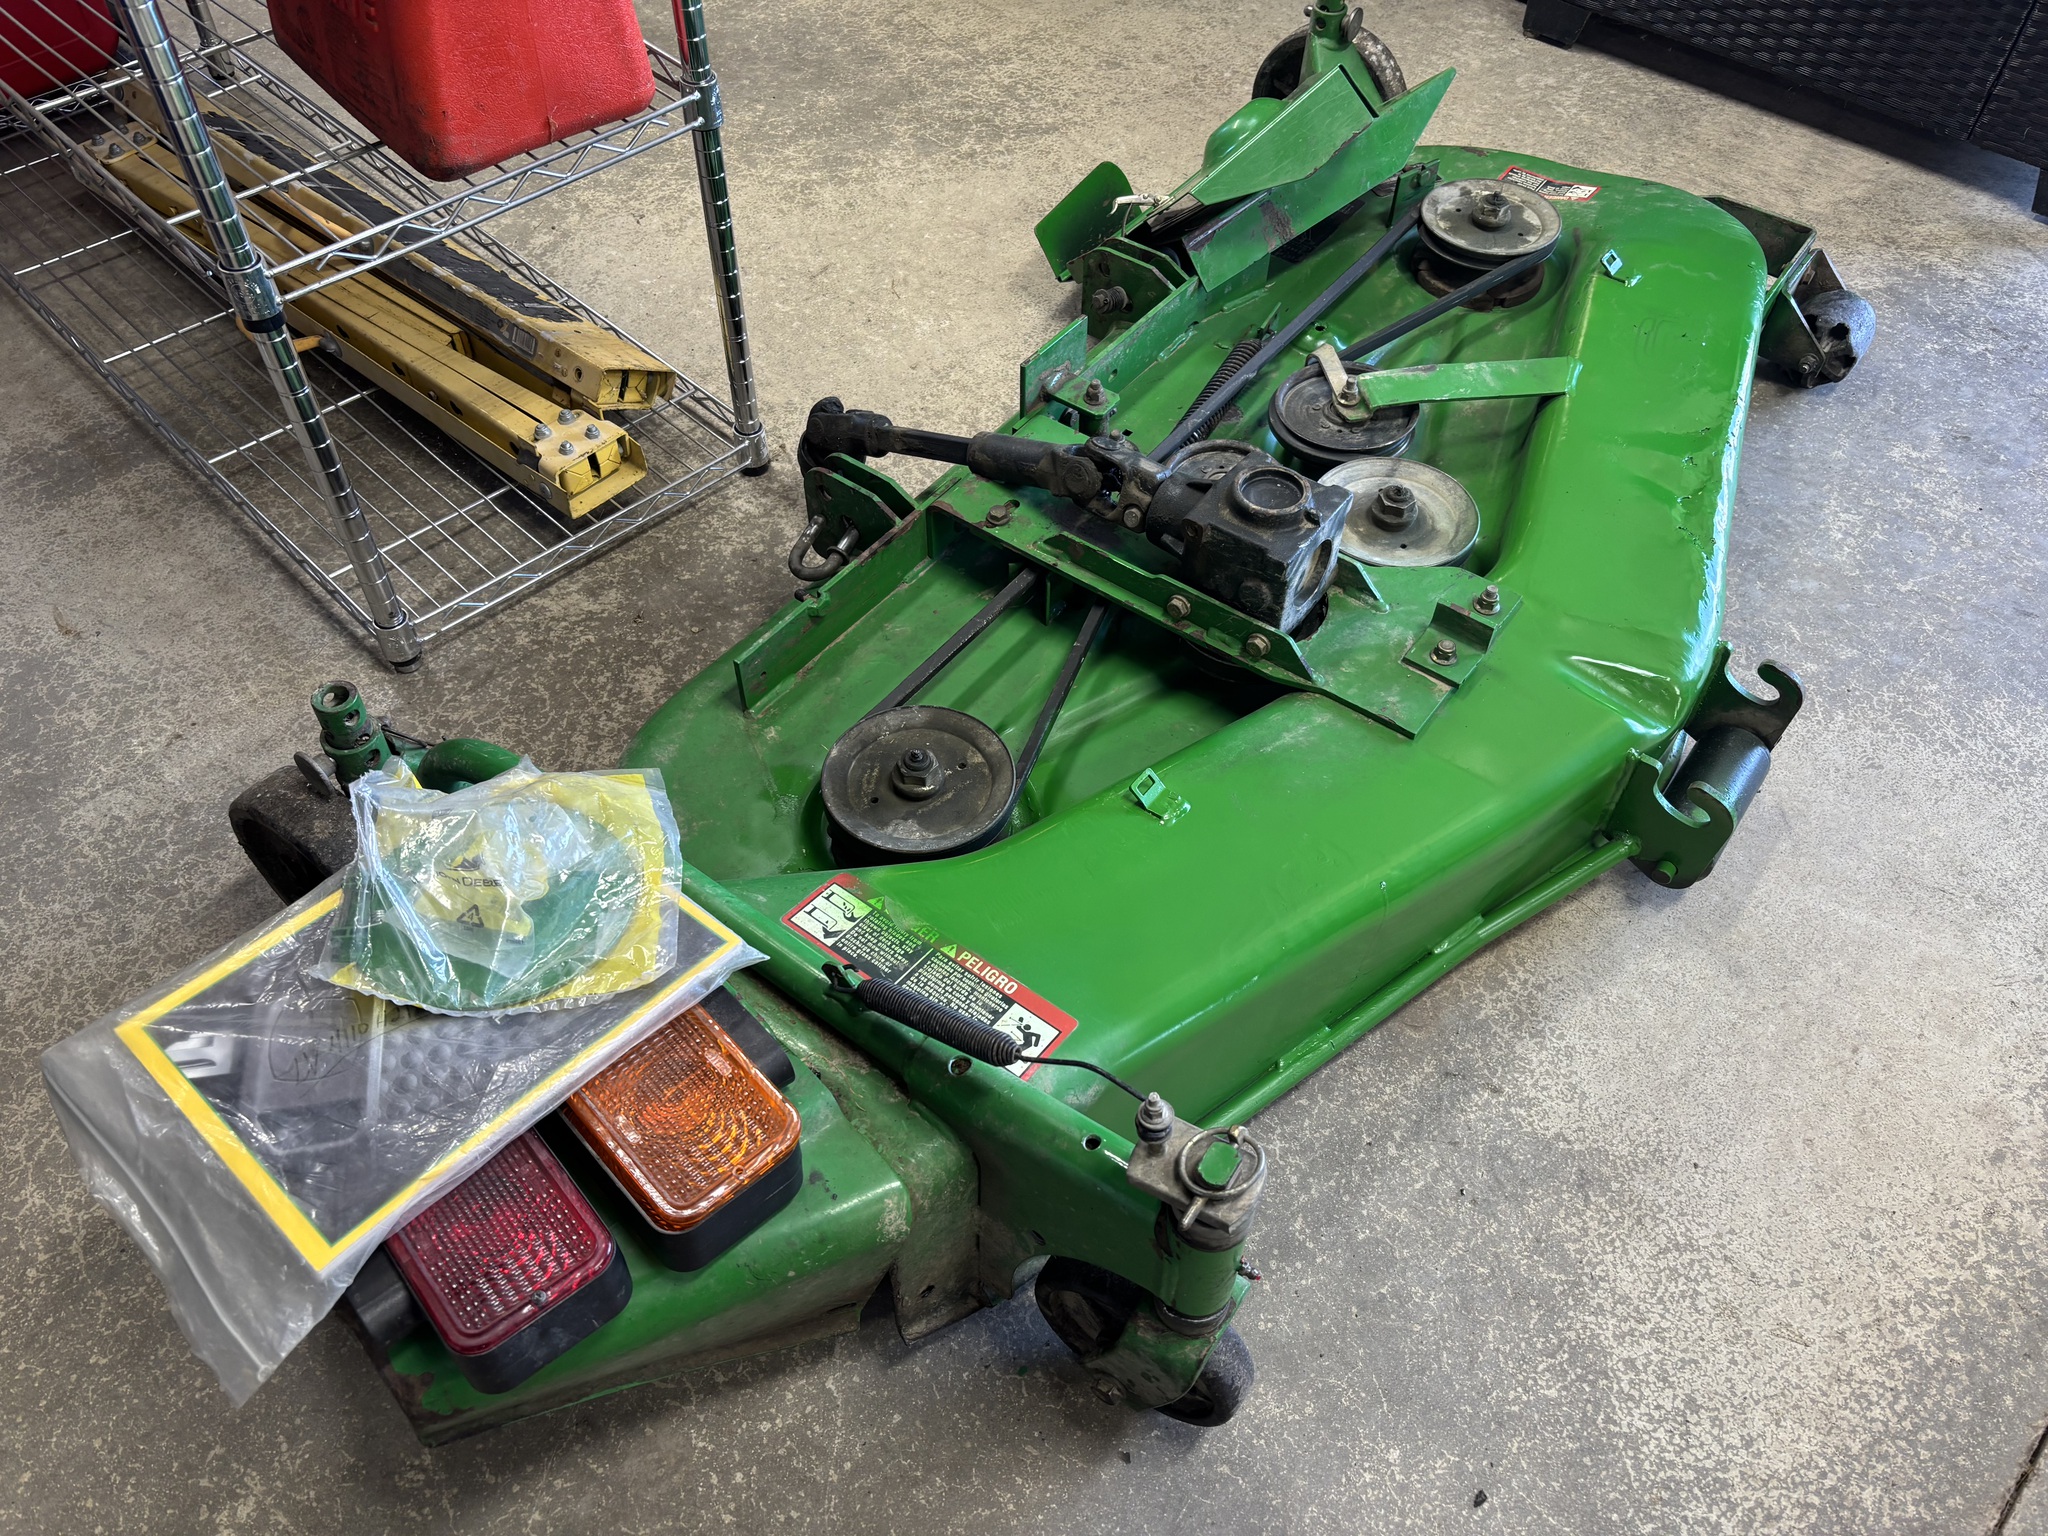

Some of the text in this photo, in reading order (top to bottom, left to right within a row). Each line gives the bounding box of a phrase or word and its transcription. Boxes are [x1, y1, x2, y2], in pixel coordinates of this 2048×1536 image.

[858, 922, 873, 932] clear
[878, 935, 892, 945] deck
[890, 944, 905, 954] edge
[862, 918, 882, 931] thrown
[900, 944, 914, 953] stay
[863, 933, 878, 943] keep
[876, 941, 895, 954] others
[866, 914, 889, 930] rotating
[887, 928, 906, 941] blades
[878, 915, 895, 926] avoid
[892, 925, 909, 937] injury
[909, 935, 922, 944] from
[840, 937, 891, 973] entire grass catcher
[841, 946, 860, 959] place.
[843, 933, 871, 952] discharge
[869, 950, 886, 962] chute
[878, 950, 900, 964] without
[921, 964, 943, 979] alejado
[951, 983, 969, 996] borde
[929, 962, 950, 977] objetos
[972, 990, 1004, 1012] mantenerse
[930, 956, 954, 973] causadas
[961, 976, 985, 993] cuchillas
[983, 991, 1009, 1009] giratorias
[934, 952, 1004, 998] Para evitar sufrir lesiones
[955, 950, 1019, 995] PELIGRO
[904, 980, 930, 998] máquina
[917, 968, 946, 988] plataforma
[951, 990, 966, 1001] corte
[968, 1002, 995, 1020] mantener
[926, 980, 945, 994] demás
[943, 992, 968, 1009] personas
[967, 1007, 992, 1025] alejadas
